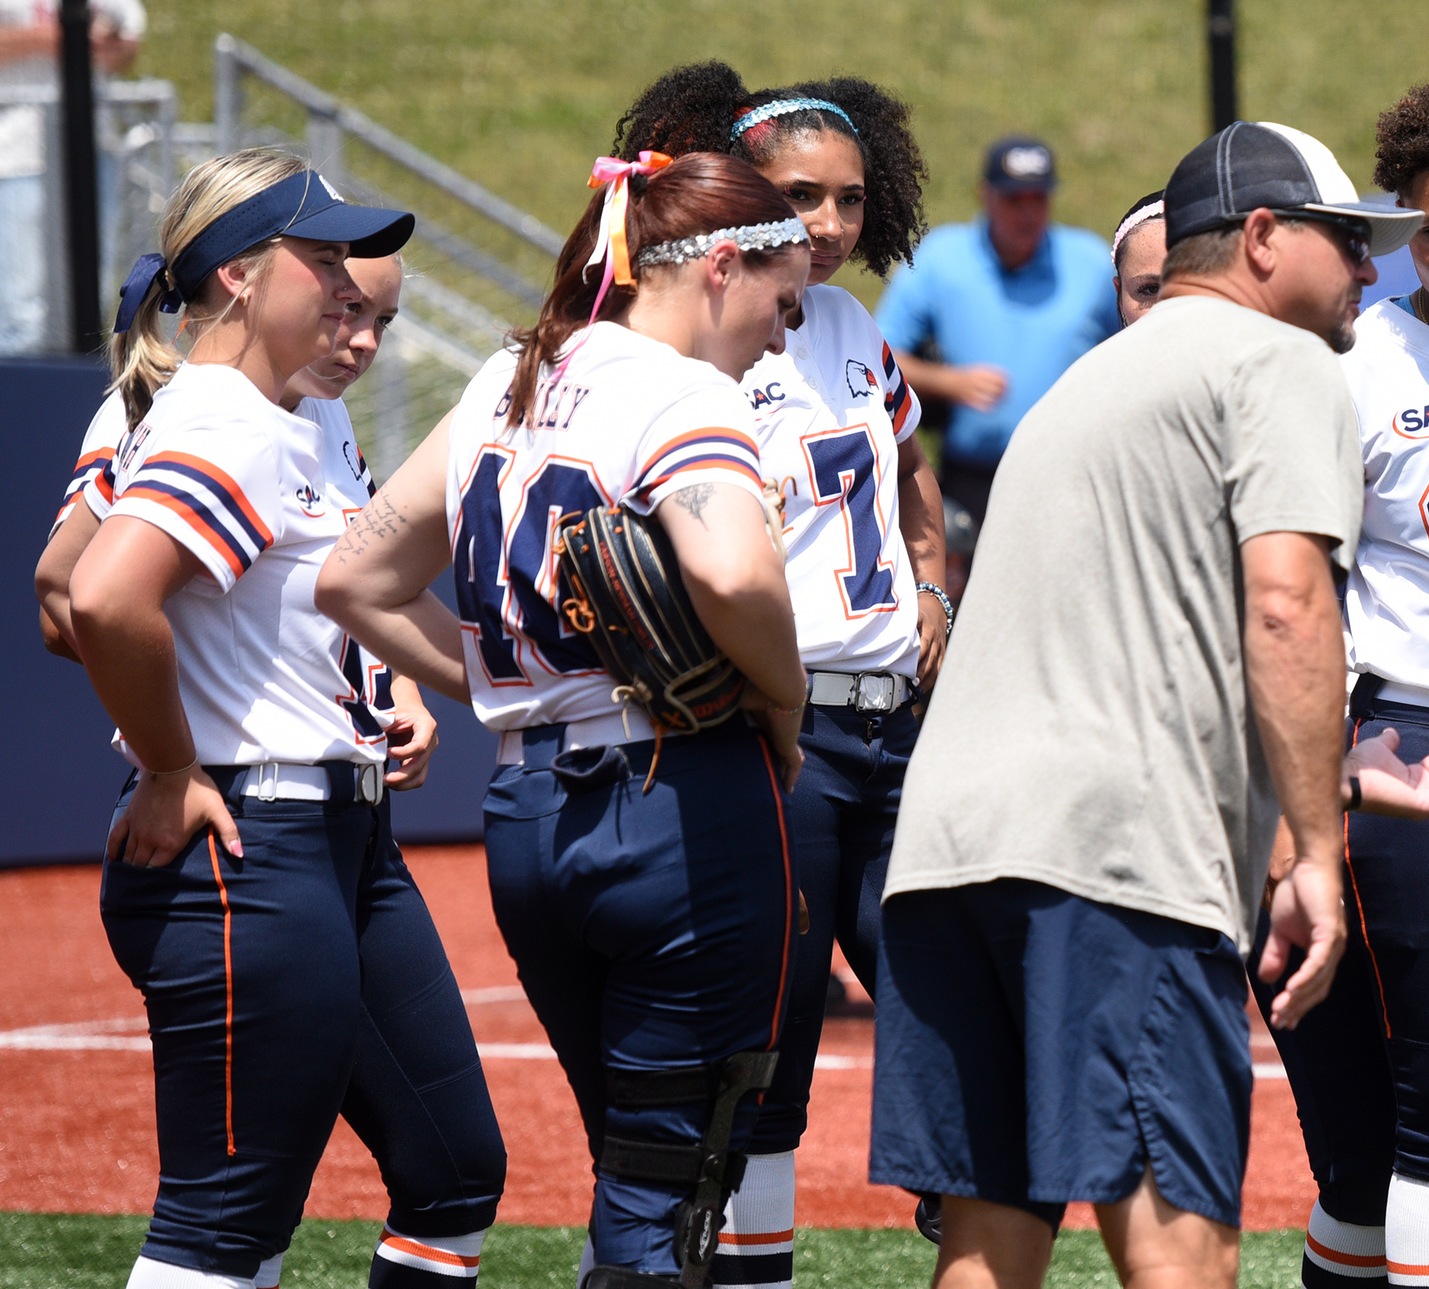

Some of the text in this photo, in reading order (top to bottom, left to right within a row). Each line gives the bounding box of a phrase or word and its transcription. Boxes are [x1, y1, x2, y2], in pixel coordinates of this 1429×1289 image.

[744, 381, 786, 410] AC
[451, 443, 616, 688] 40
[799, 423, 899, 620] 7
